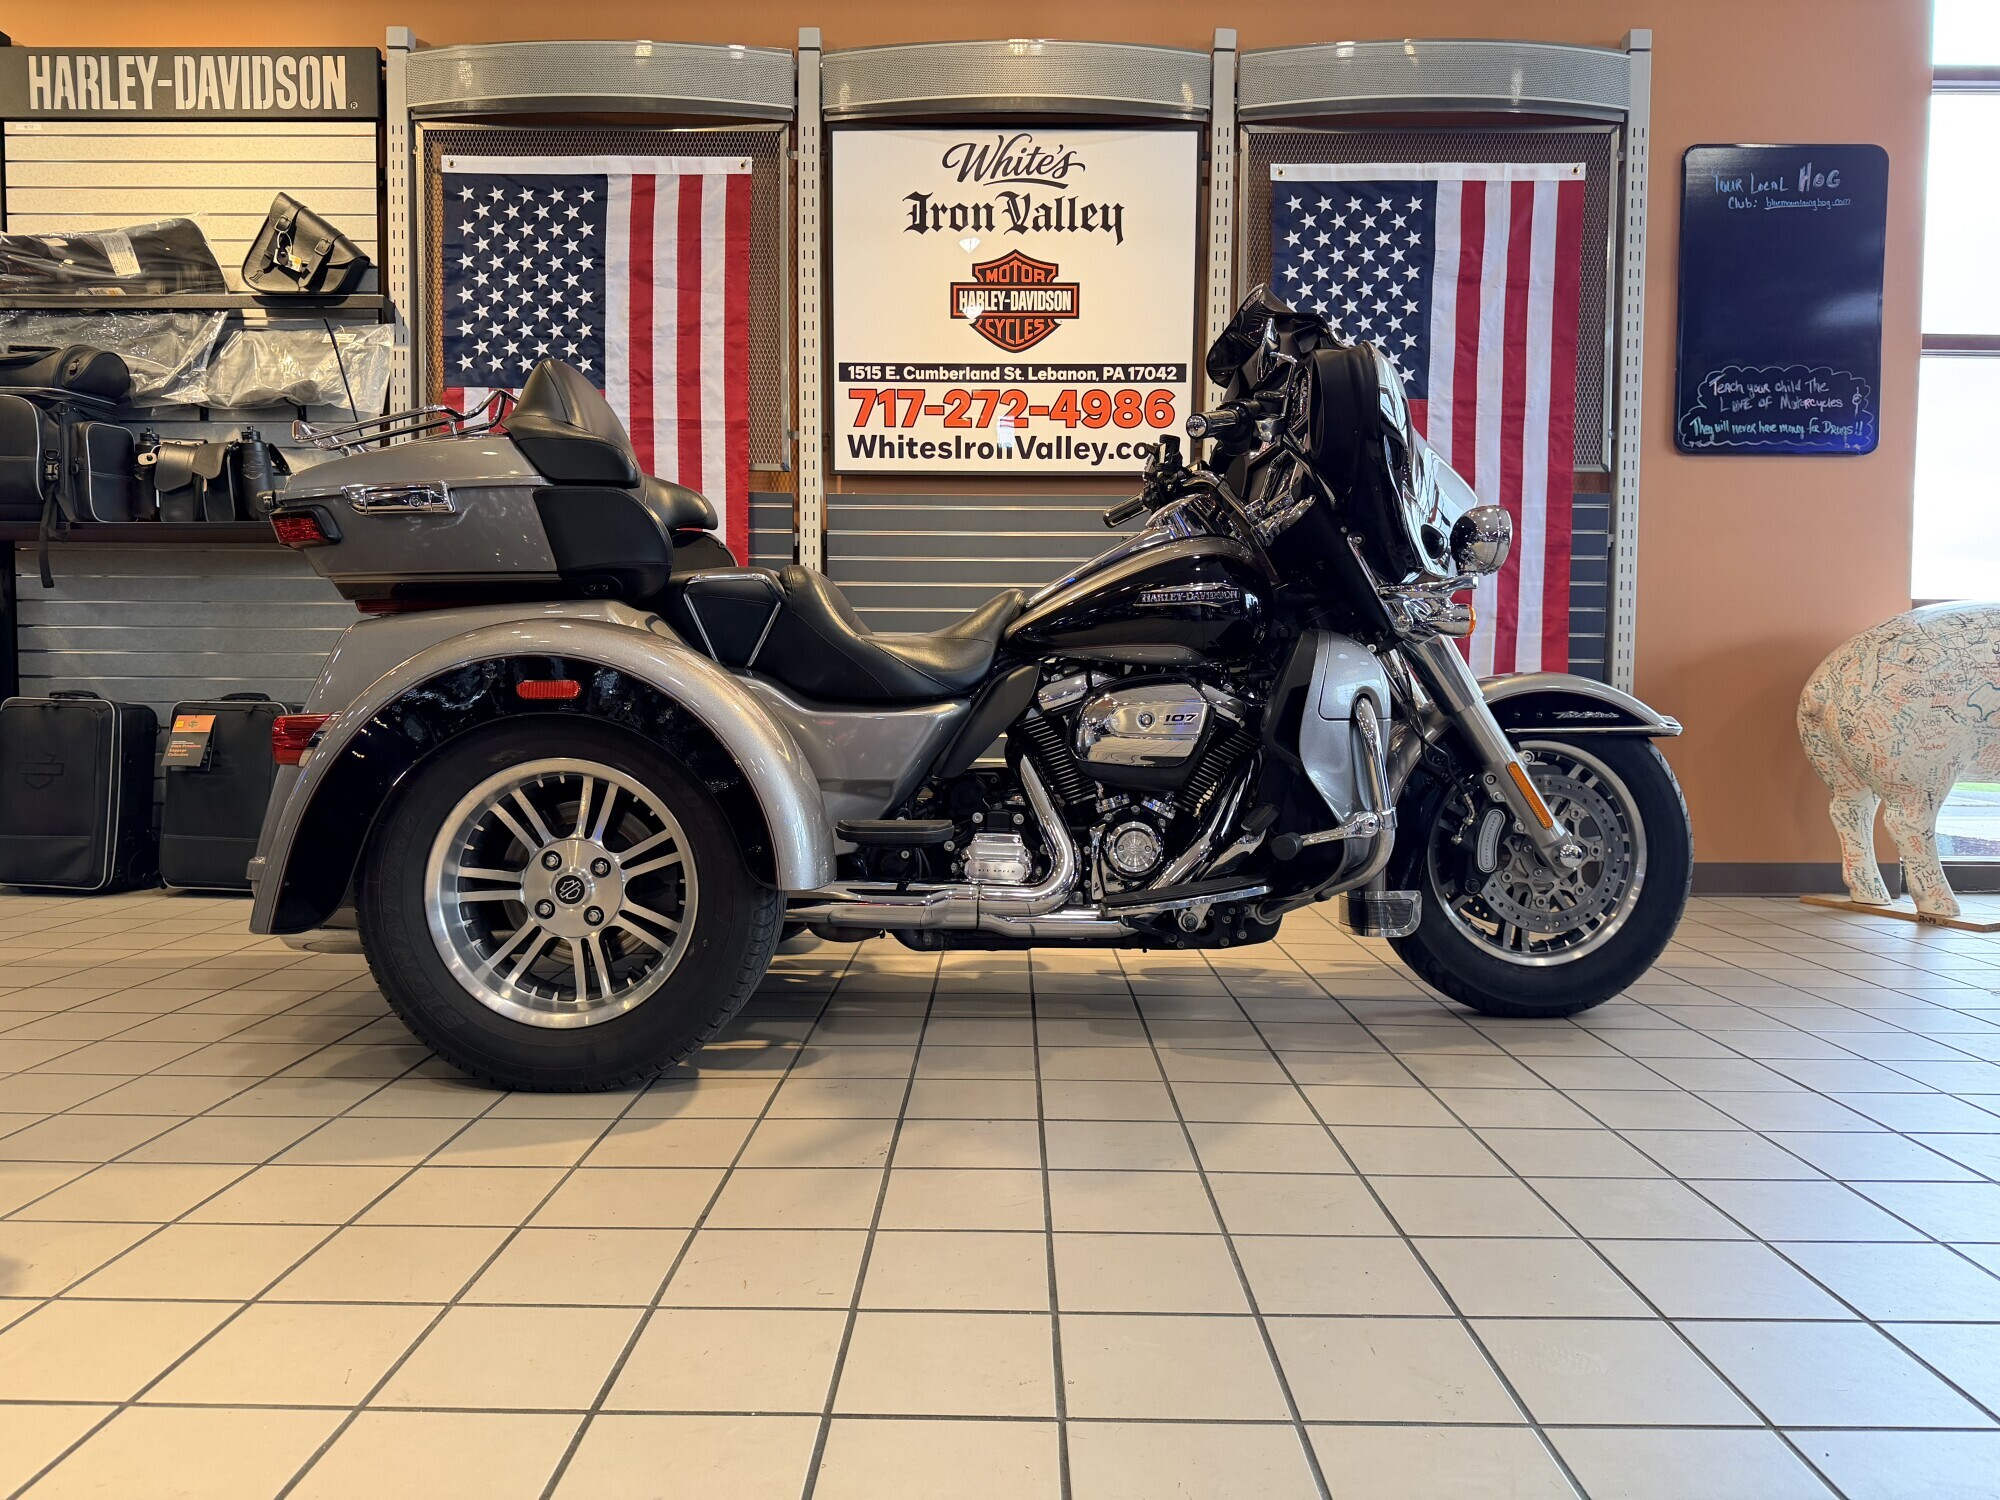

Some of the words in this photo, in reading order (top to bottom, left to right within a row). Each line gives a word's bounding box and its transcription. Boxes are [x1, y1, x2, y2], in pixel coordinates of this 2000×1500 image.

[28, 55, 347, 110] HARLEY-DAVIDSON
[941, 132, 1086, 189] White's
[902, 191, 996, 235] Iron
[995, 190, 1125, 245] Valley
[985, 259, 1046, 283] MOTOR
[959, 290, 1072, 312] HARLEY-DAVIDSON
[985, 318, 1045, 345] CYCLES
[847, 365, 882, 380] 1515
[885, 366, 900, 380] E.
[903, 366, 1000, 381] Cumberland
[1004, 366, 1025, 381] St.
[1028, 366, 1099, 383] Lebanon,
[1102, 367, 1126, 381] PA
[1128, 367, 1178, 381] 17042
[848, 387, 1176, 429] 717-272-4986
[847, 434, 1151, 466] WhitesIronValley.co
[1141, 591, 1239, 603] HARLEY-DAVIDSON
[1165, 713, 1199, 723] 107
